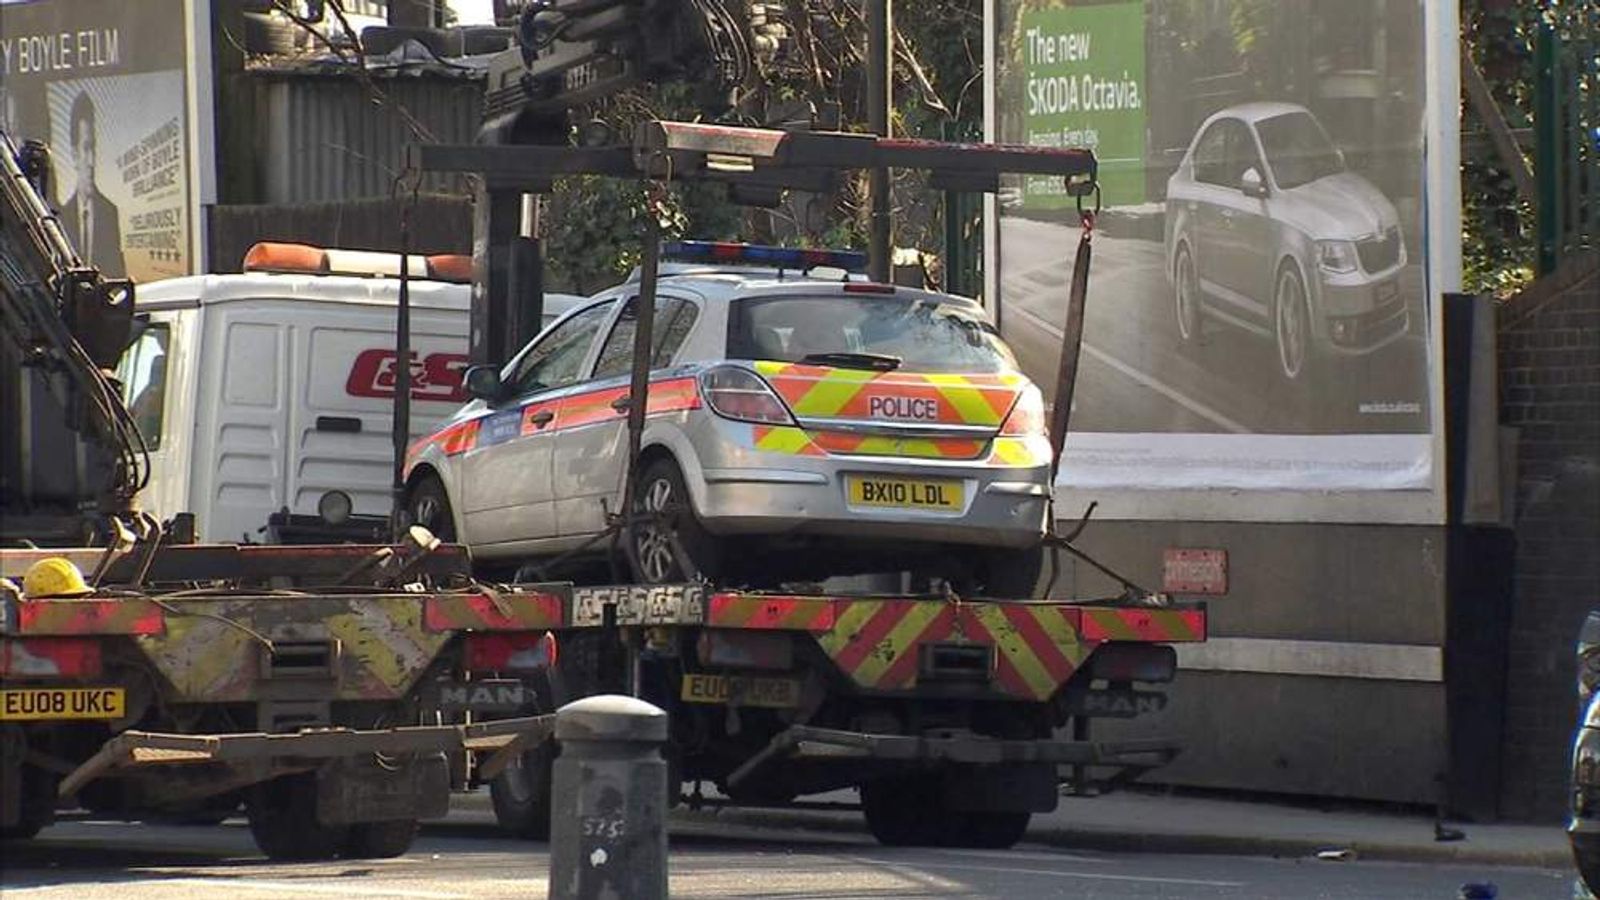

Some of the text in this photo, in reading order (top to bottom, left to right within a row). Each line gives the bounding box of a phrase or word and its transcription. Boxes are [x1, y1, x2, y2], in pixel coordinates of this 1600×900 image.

[20, 34, 71, 72] BOYLE
[78, 28, 119, 67] FILM
[1026, 26, 1090, 65] The new
[1028, 69, 1141, 117] ŠKODA Octavia.
[869, 397, 936, 419] POLICE
[862, 482, 950, 505] BX10 LDL
[6, 690, 116, 714] EU08 UKC
[441, 686, 525, 704] MAN
